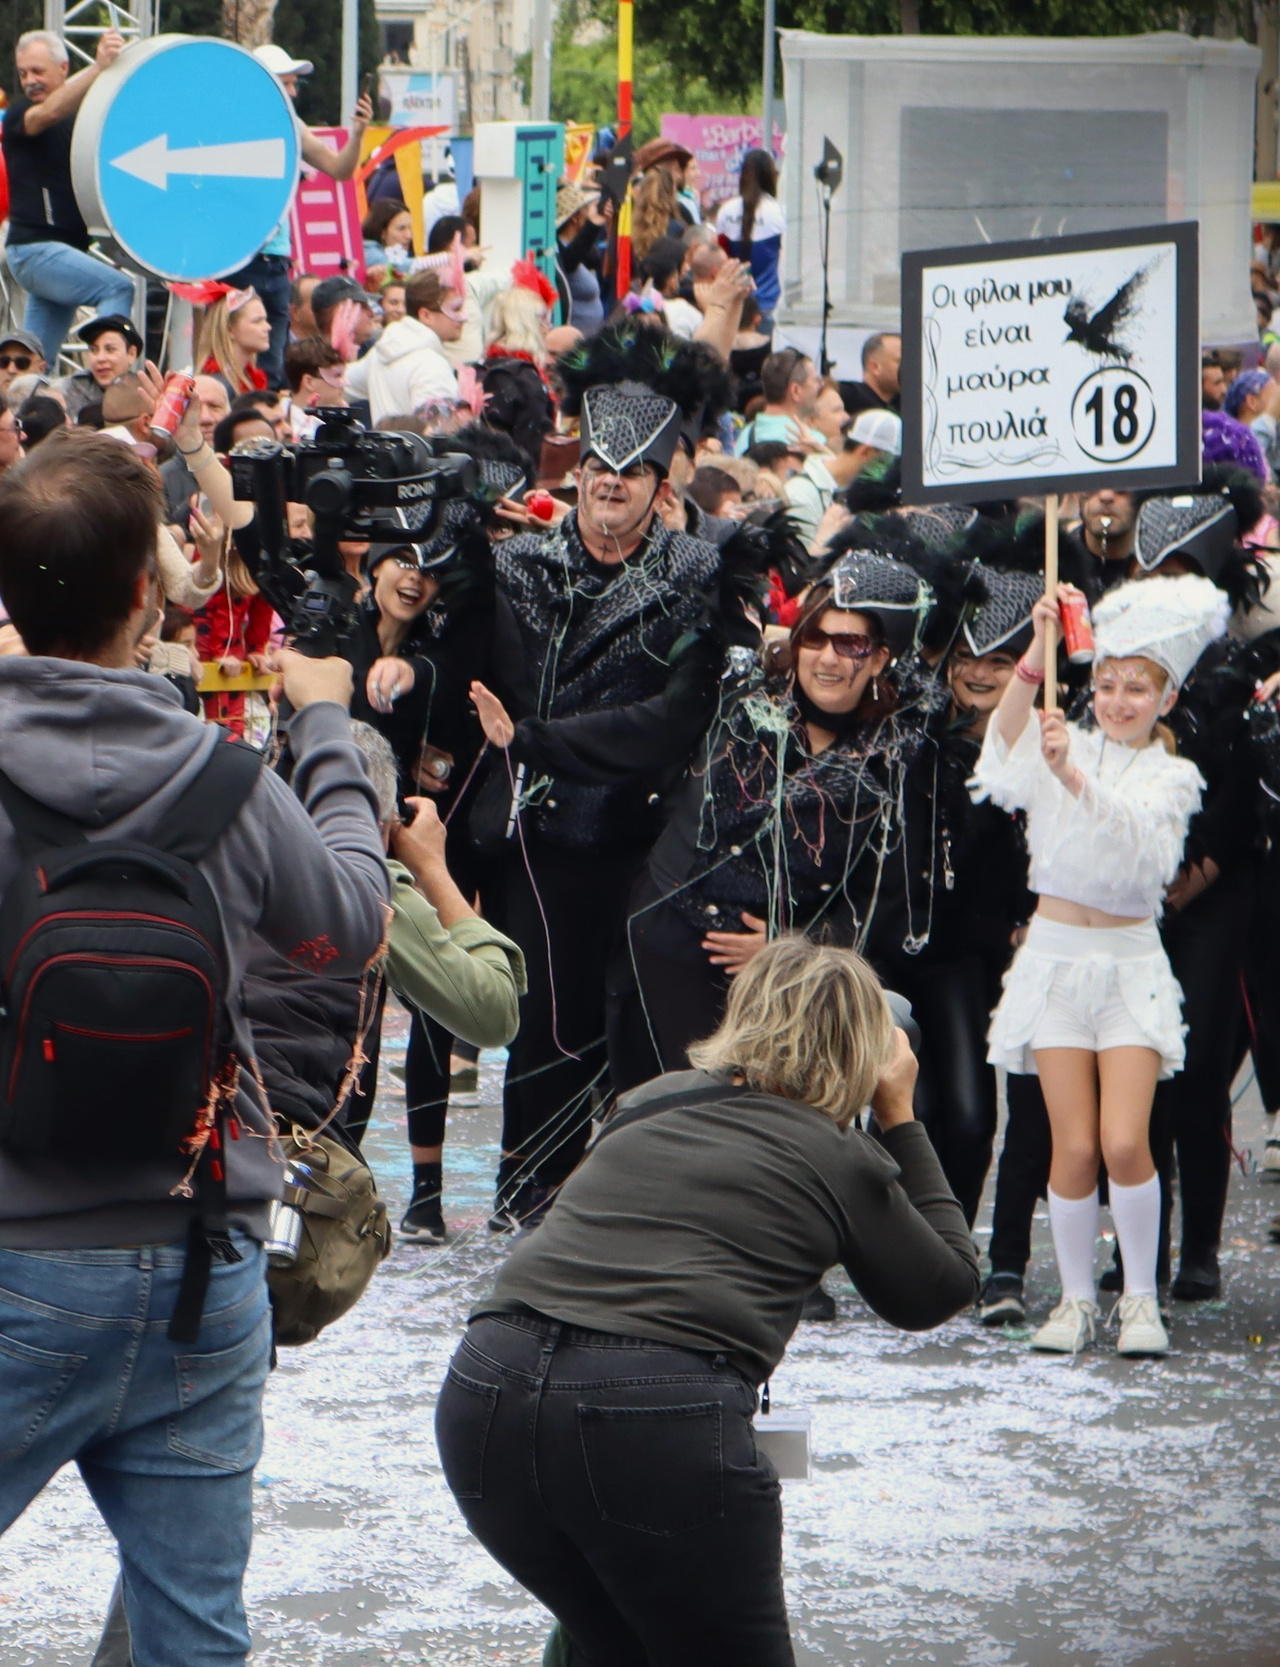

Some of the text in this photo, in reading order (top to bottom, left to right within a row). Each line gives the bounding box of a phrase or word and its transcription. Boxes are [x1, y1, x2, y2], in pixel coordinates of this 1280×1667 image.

[932, 278, 1073, 312] Οι φίλοι μου
[964, 320, 1032, 347] είναι
[946, 364, 1050, 398] μαύρα
[947, 407, 1048, 445] πουλιά
[1085, 384, 1138, 446] 18
[397, 480, 436, 500] RONIN
